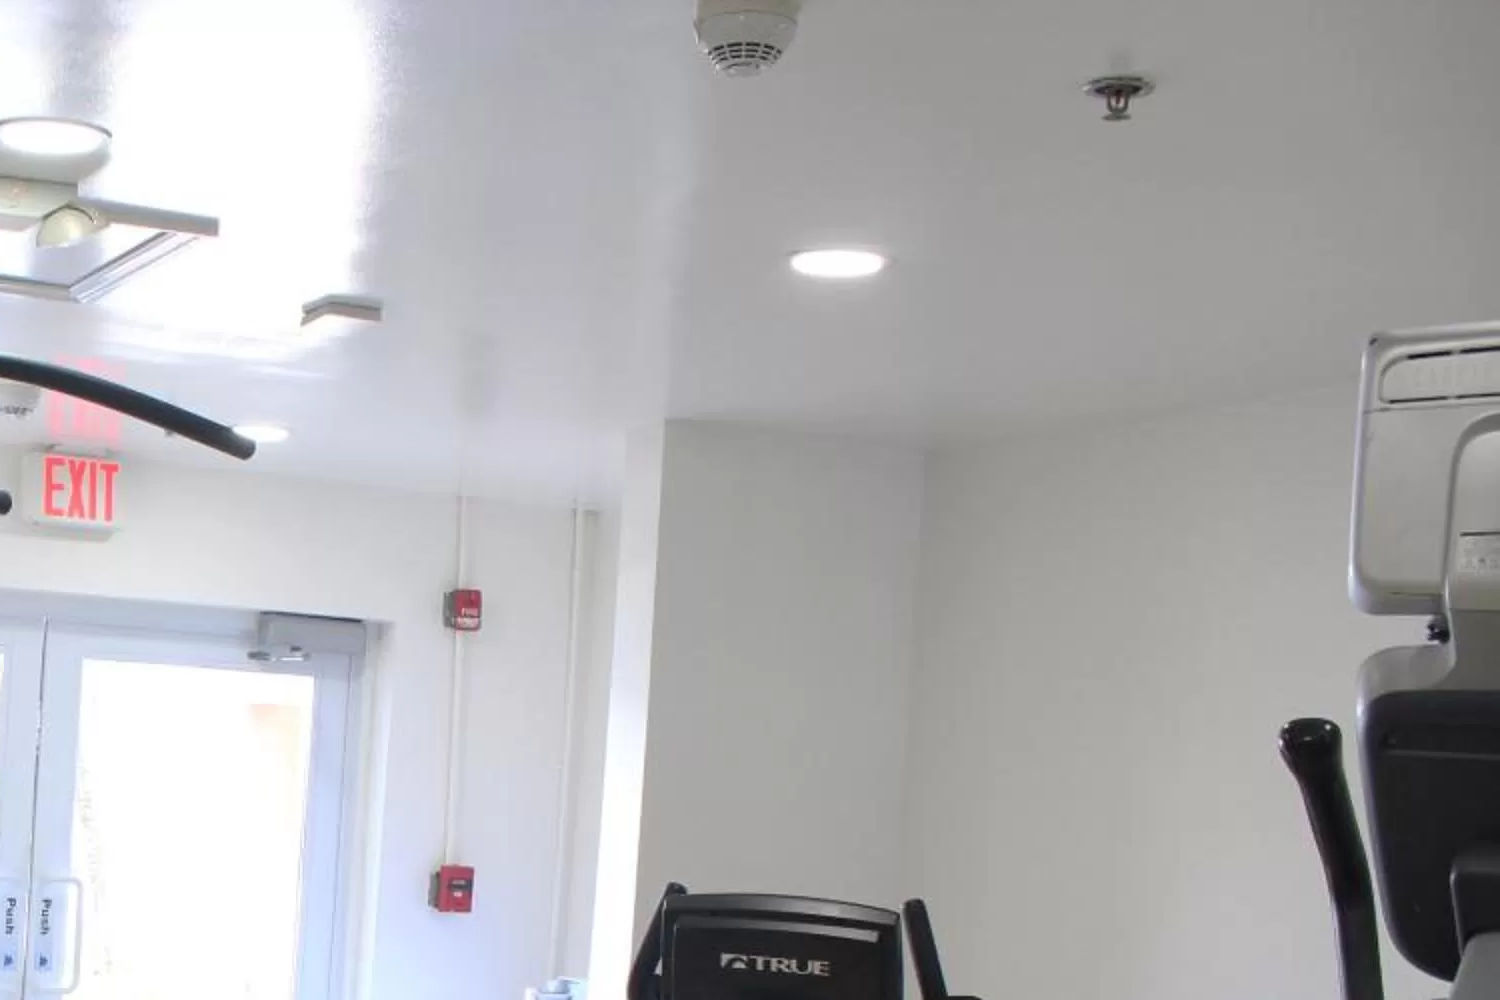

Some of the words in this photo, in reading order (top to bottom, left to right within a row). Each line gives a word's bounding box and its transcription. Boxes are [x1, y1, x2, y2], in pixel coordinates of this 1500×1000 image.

[44, 457, 119, 522] EXIT
[5, 898, 17, 935] Push
[40, 899, 52, 935] Push
[750, 955, 831, 977] TRUE
